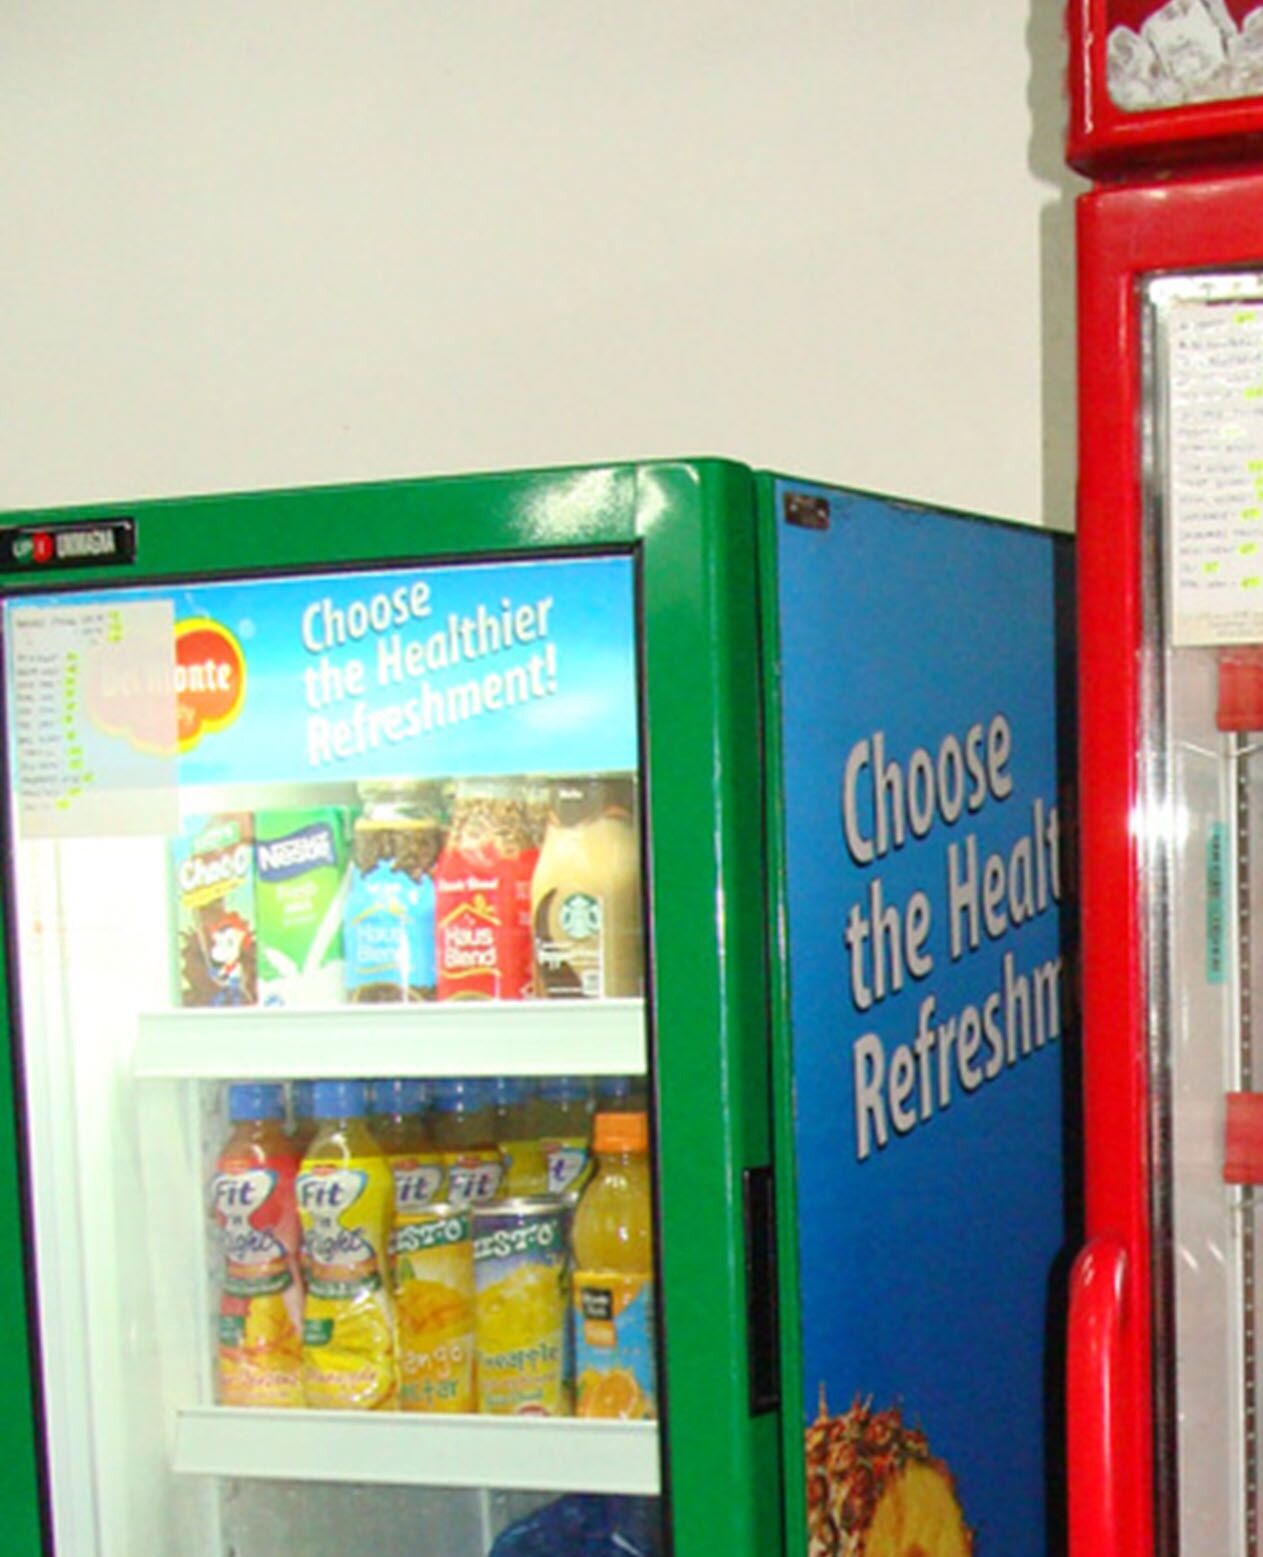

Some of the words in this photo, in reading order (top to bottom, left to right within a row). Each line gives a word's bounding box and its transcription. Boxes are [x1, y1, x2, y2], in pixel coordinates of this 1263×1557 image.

[303, 582, 431, 652] Choose
[303, 654, 365, 712] the
[377, 596, 554, 683] Healthier
[174, 660, 232, 692] onte
[308, 645, 558, 766] Refreshment!
[843, 714, 1012, 865] Choose
[845, 877, 933, 1012] the
[947, 798, 1061, 962] Healt
[853, 950, 1061, 1162] Refreshm
[214, 1179, 256, 1206] Fit
[301, 1180, 345, 1207] Fit
[449, 1165, 495, 1201] Fit
